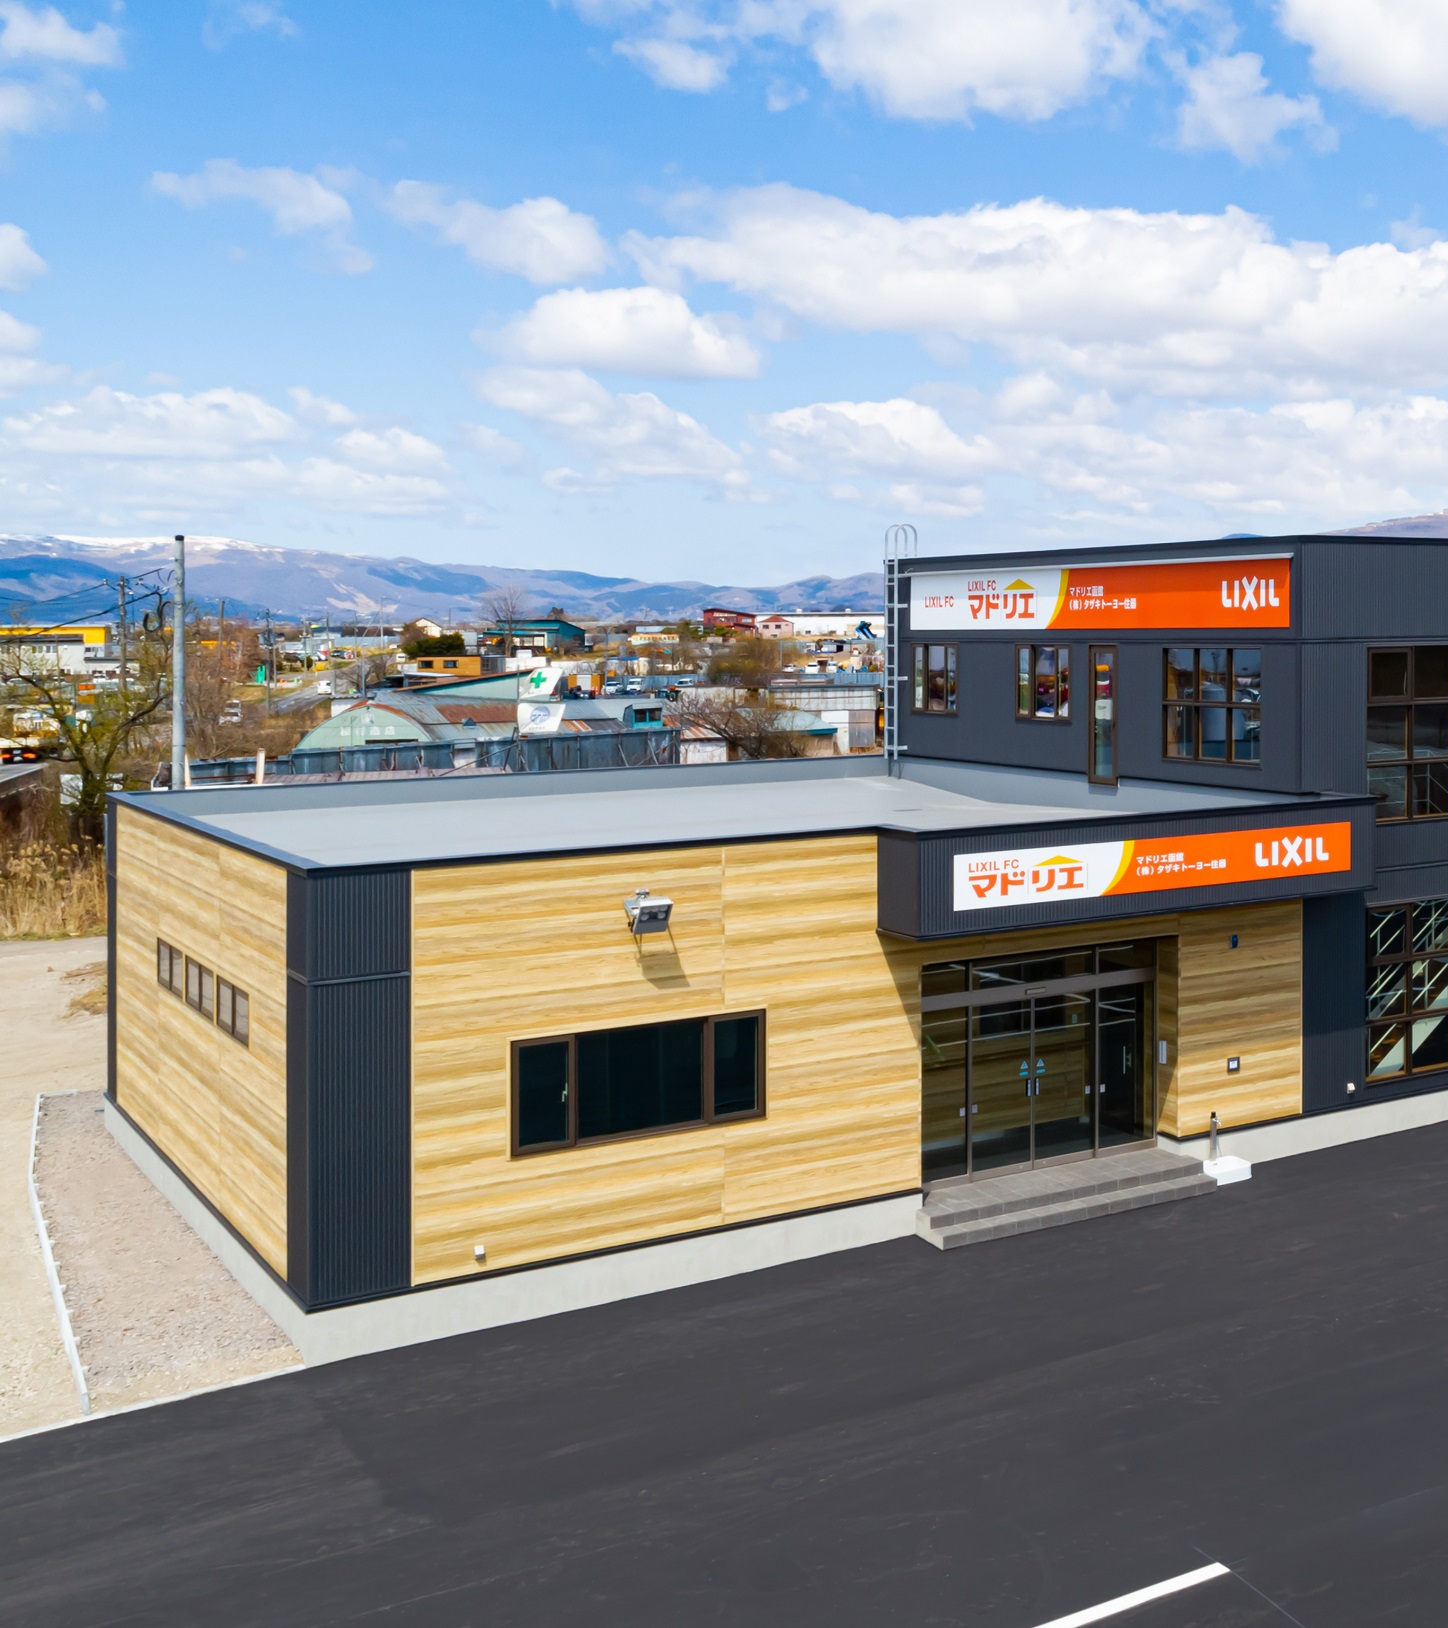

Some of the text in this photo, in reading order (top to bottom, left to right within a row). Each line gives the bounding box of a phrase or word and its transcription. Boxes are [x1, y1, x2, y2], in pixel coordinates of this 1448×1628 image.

[967, 580, 997, 592] LIXIL FC
[1221, 575, 1280, 611] LIXIL
[924, 595, 954, 608] LIXIL FC
[967, 593, 1035, 620] マドリエ
[1255, 835, 1329, 868] LIXIL
[968, 859, 1019, 873] LIXIL FC
[968, 866, 1084, 899] マドリエ
